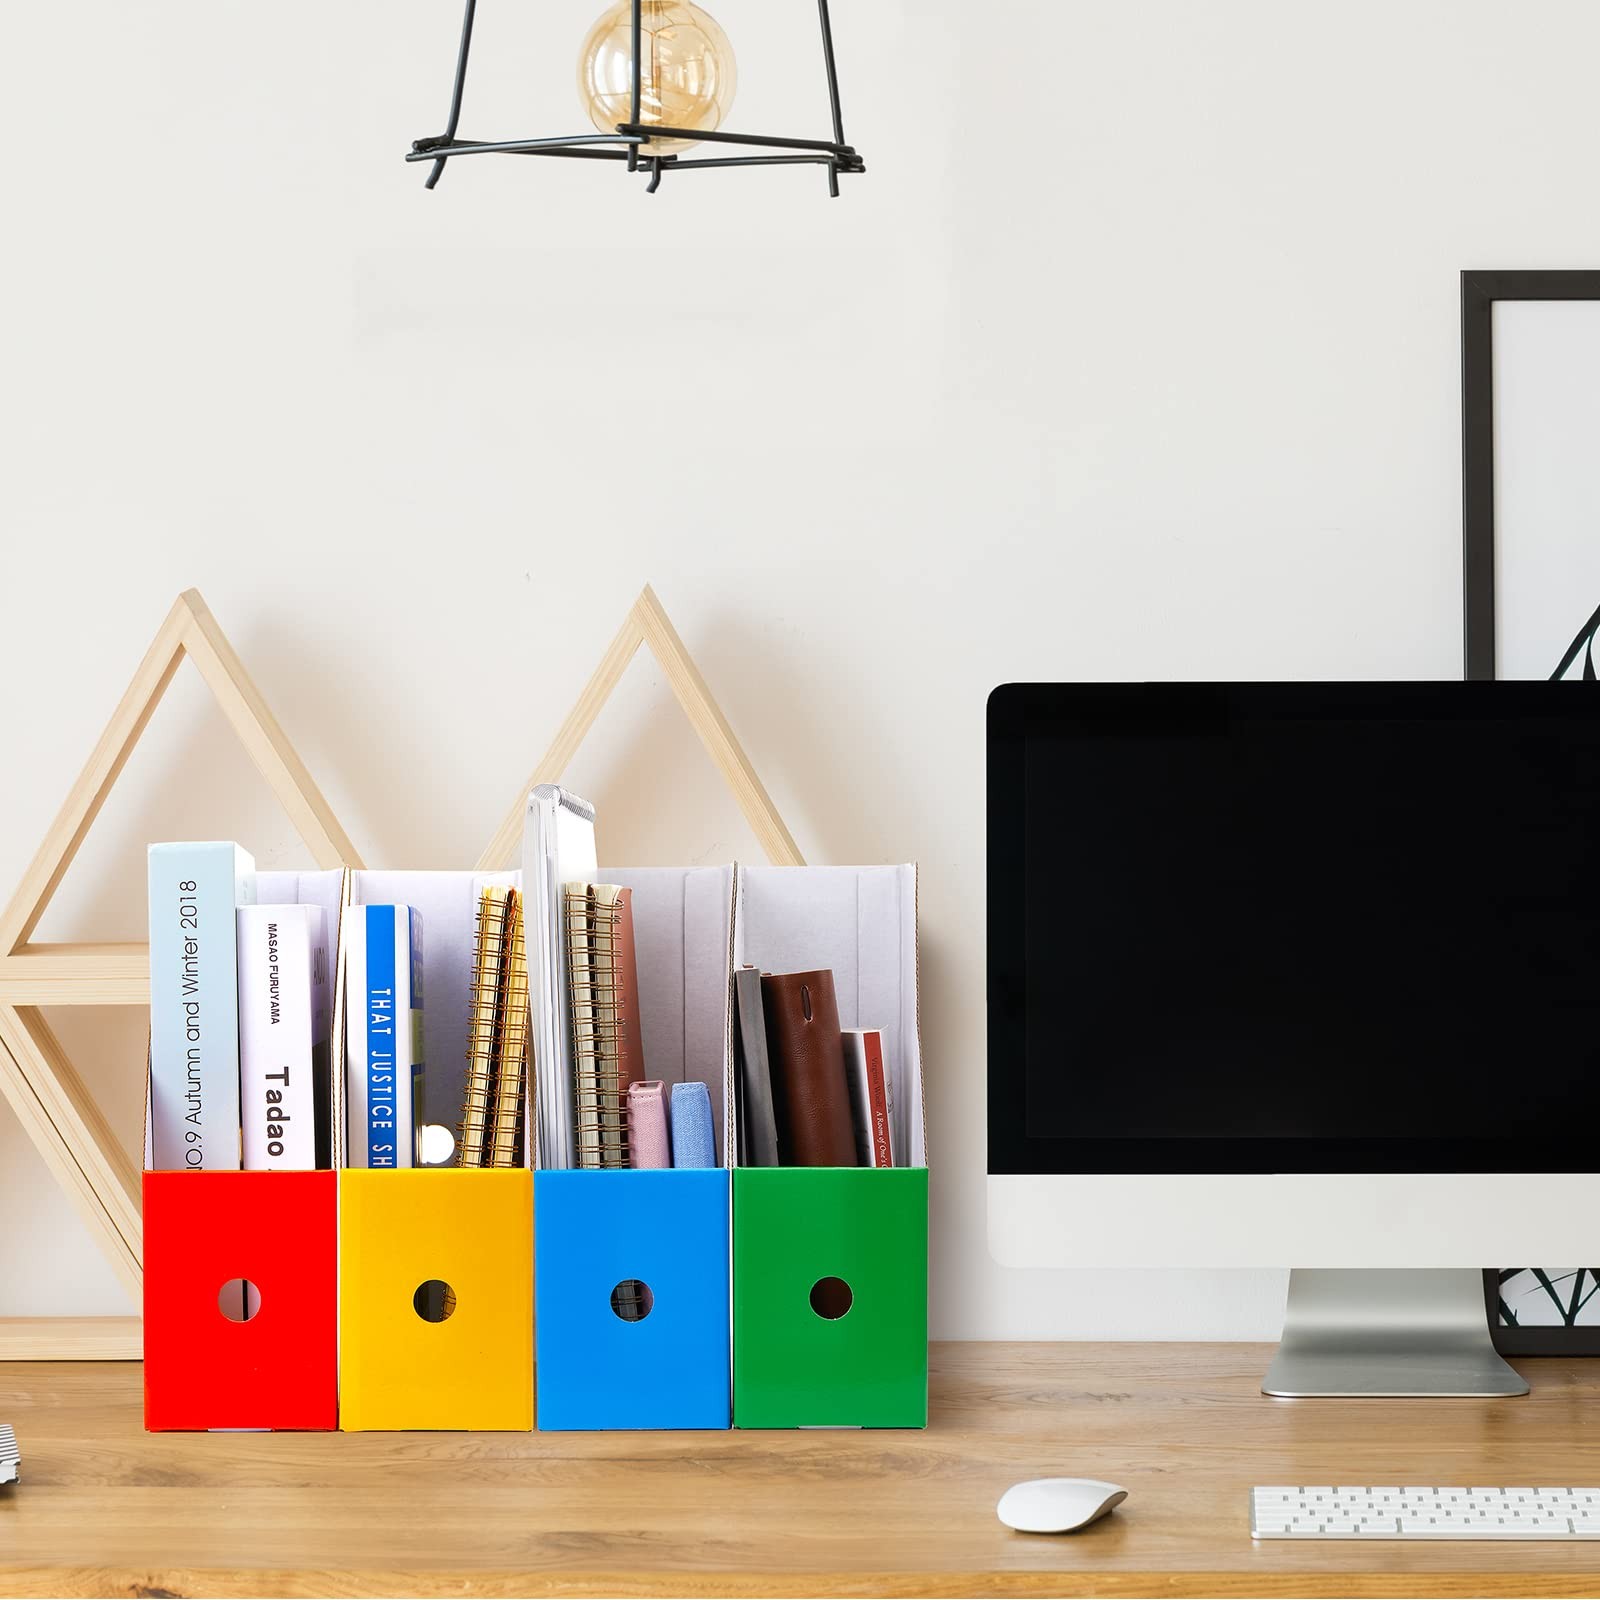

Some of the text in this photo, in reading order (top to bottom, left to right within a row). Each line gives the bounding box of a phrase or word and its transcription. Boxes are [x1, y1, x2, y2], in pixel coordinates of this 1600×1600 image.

[268, 923, 280, 1025] MASAO FURUYAMA
[179, 880, 203, 1170] O.9 Autumn and Winter 2018
[371, 988, 392, 1035] THAT
[371, 1050, 393, 1128] JUSTICE
[870, 1057, 880, 1085] Virginia
[265, 1066, 291, 1157] Tadao
[876, 1118, 884, 1137] Room
[877, 1136, 887, 1145] of
